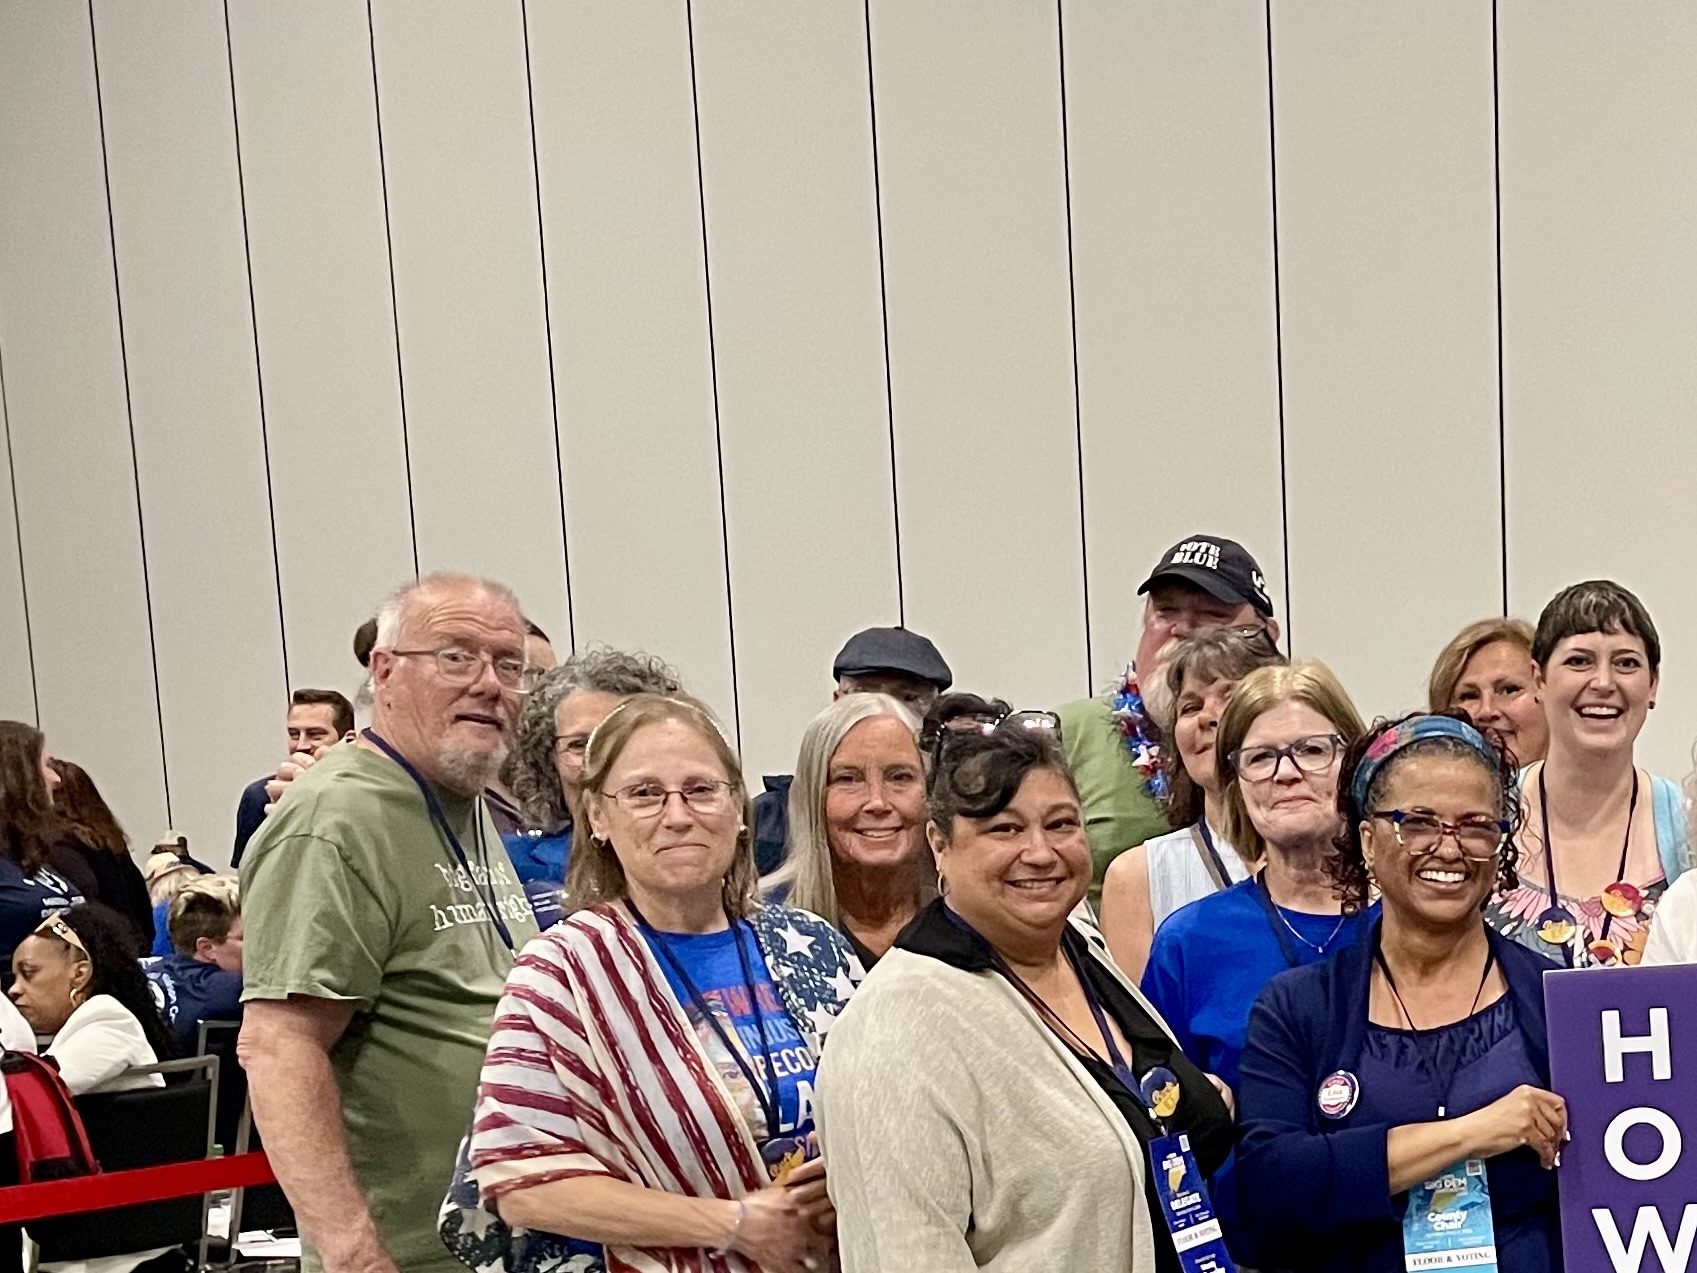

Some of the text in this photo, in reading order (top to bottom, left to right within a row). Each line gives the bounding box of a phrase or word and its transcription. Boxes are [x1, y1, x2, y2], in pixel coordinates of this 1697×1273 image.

[1170, 552, 1219, 570] BLUE
[1427, 1210, 1468, 1225] County
[1412, 1252, 1491, 1266] FLOOR & VOTING
